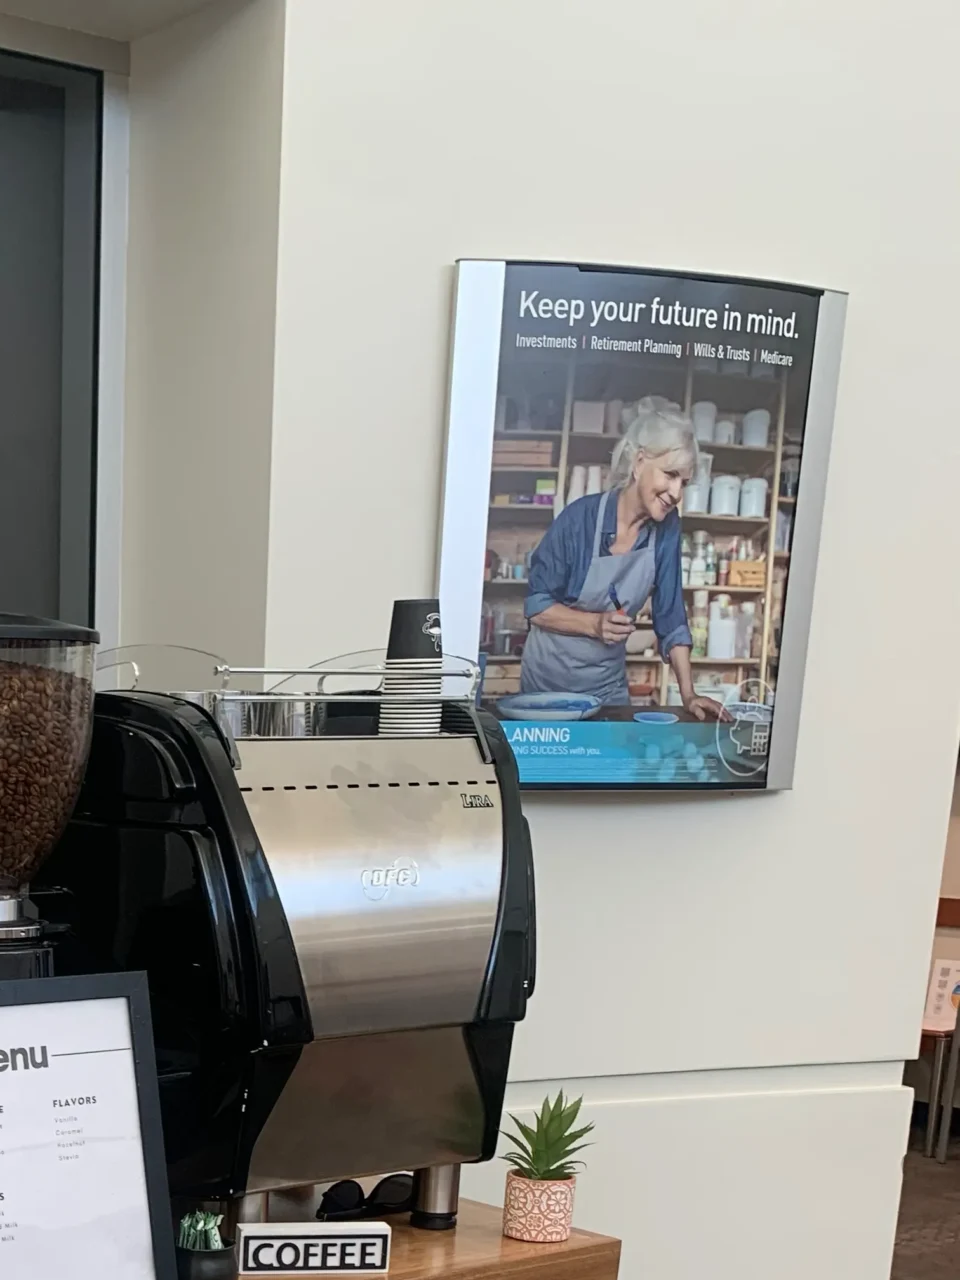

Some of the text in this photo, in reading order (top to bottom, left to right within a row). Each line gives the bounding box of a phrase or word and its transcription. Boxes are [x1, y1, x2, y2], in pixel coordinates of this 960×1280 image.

[519, 291, 799, 339] Keep your future in mind.
[516, 333, 577, 349] Investments
[591, 336, 682, 358] Retirement Planning
[694, 343, 750, 361] Wills & Trusts
[760, 349, 793, 367] Medicare
[530, 746, 568, 755] SUCCESS
[569, 746, 585, 755] with
[52, 1095, 97, 1108] FLAVORS
[54, 1115, 78, 1124] Vanilla
[55, 1128, 83, 1137] Caramel
[58, 1153, 79, 1162] Stevia
[252, 1241, 377, 1268] COFFEE
